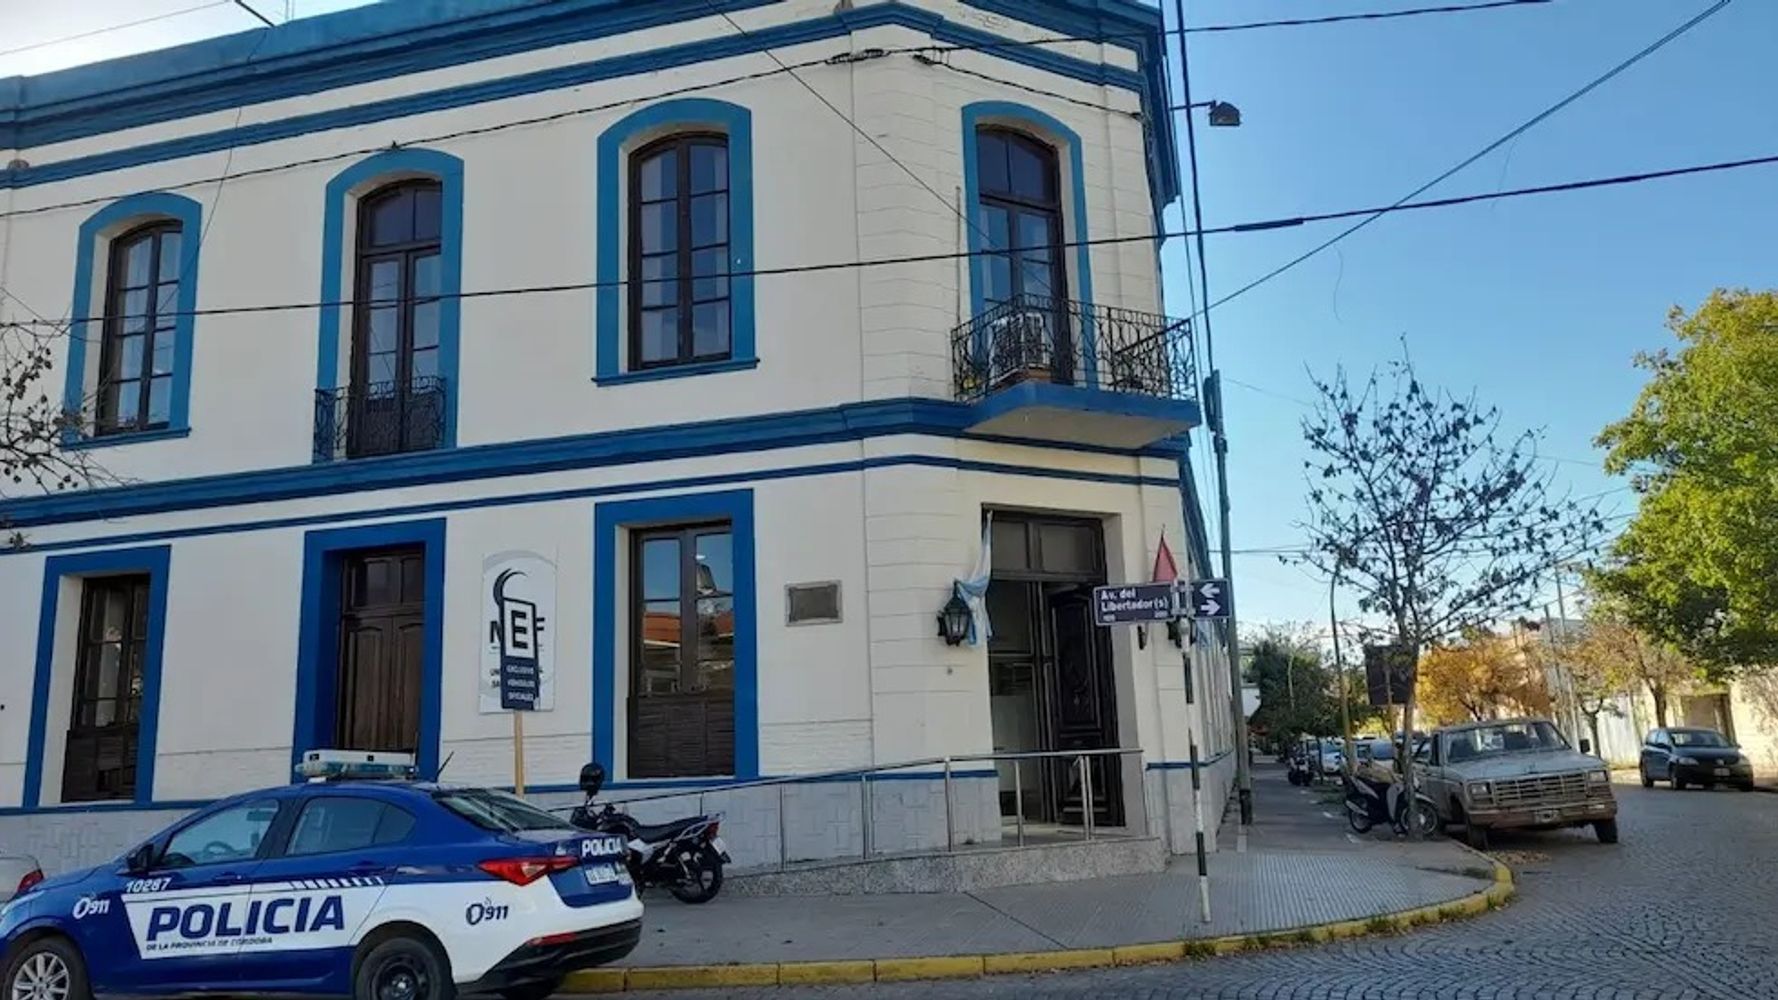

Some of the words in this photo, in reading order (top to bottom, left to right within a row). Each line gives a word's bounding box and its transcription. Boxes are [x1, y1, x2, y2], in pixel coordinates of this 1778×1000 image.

[1101, 589, 1117, 600] Av.
[1120, 587, 1136, 599] del
[1101, 596, 1168, 612] Libertador(s)
[511, 609, 529, 650] E
[582, 837, 622, 858] POLICIA
[126, 877, 171, 894] 10287
[146, 895, 345, 942] POLICIA
[159, 943, 168, 951] LA
[170, 939, 216, 950] PROVINCIA
